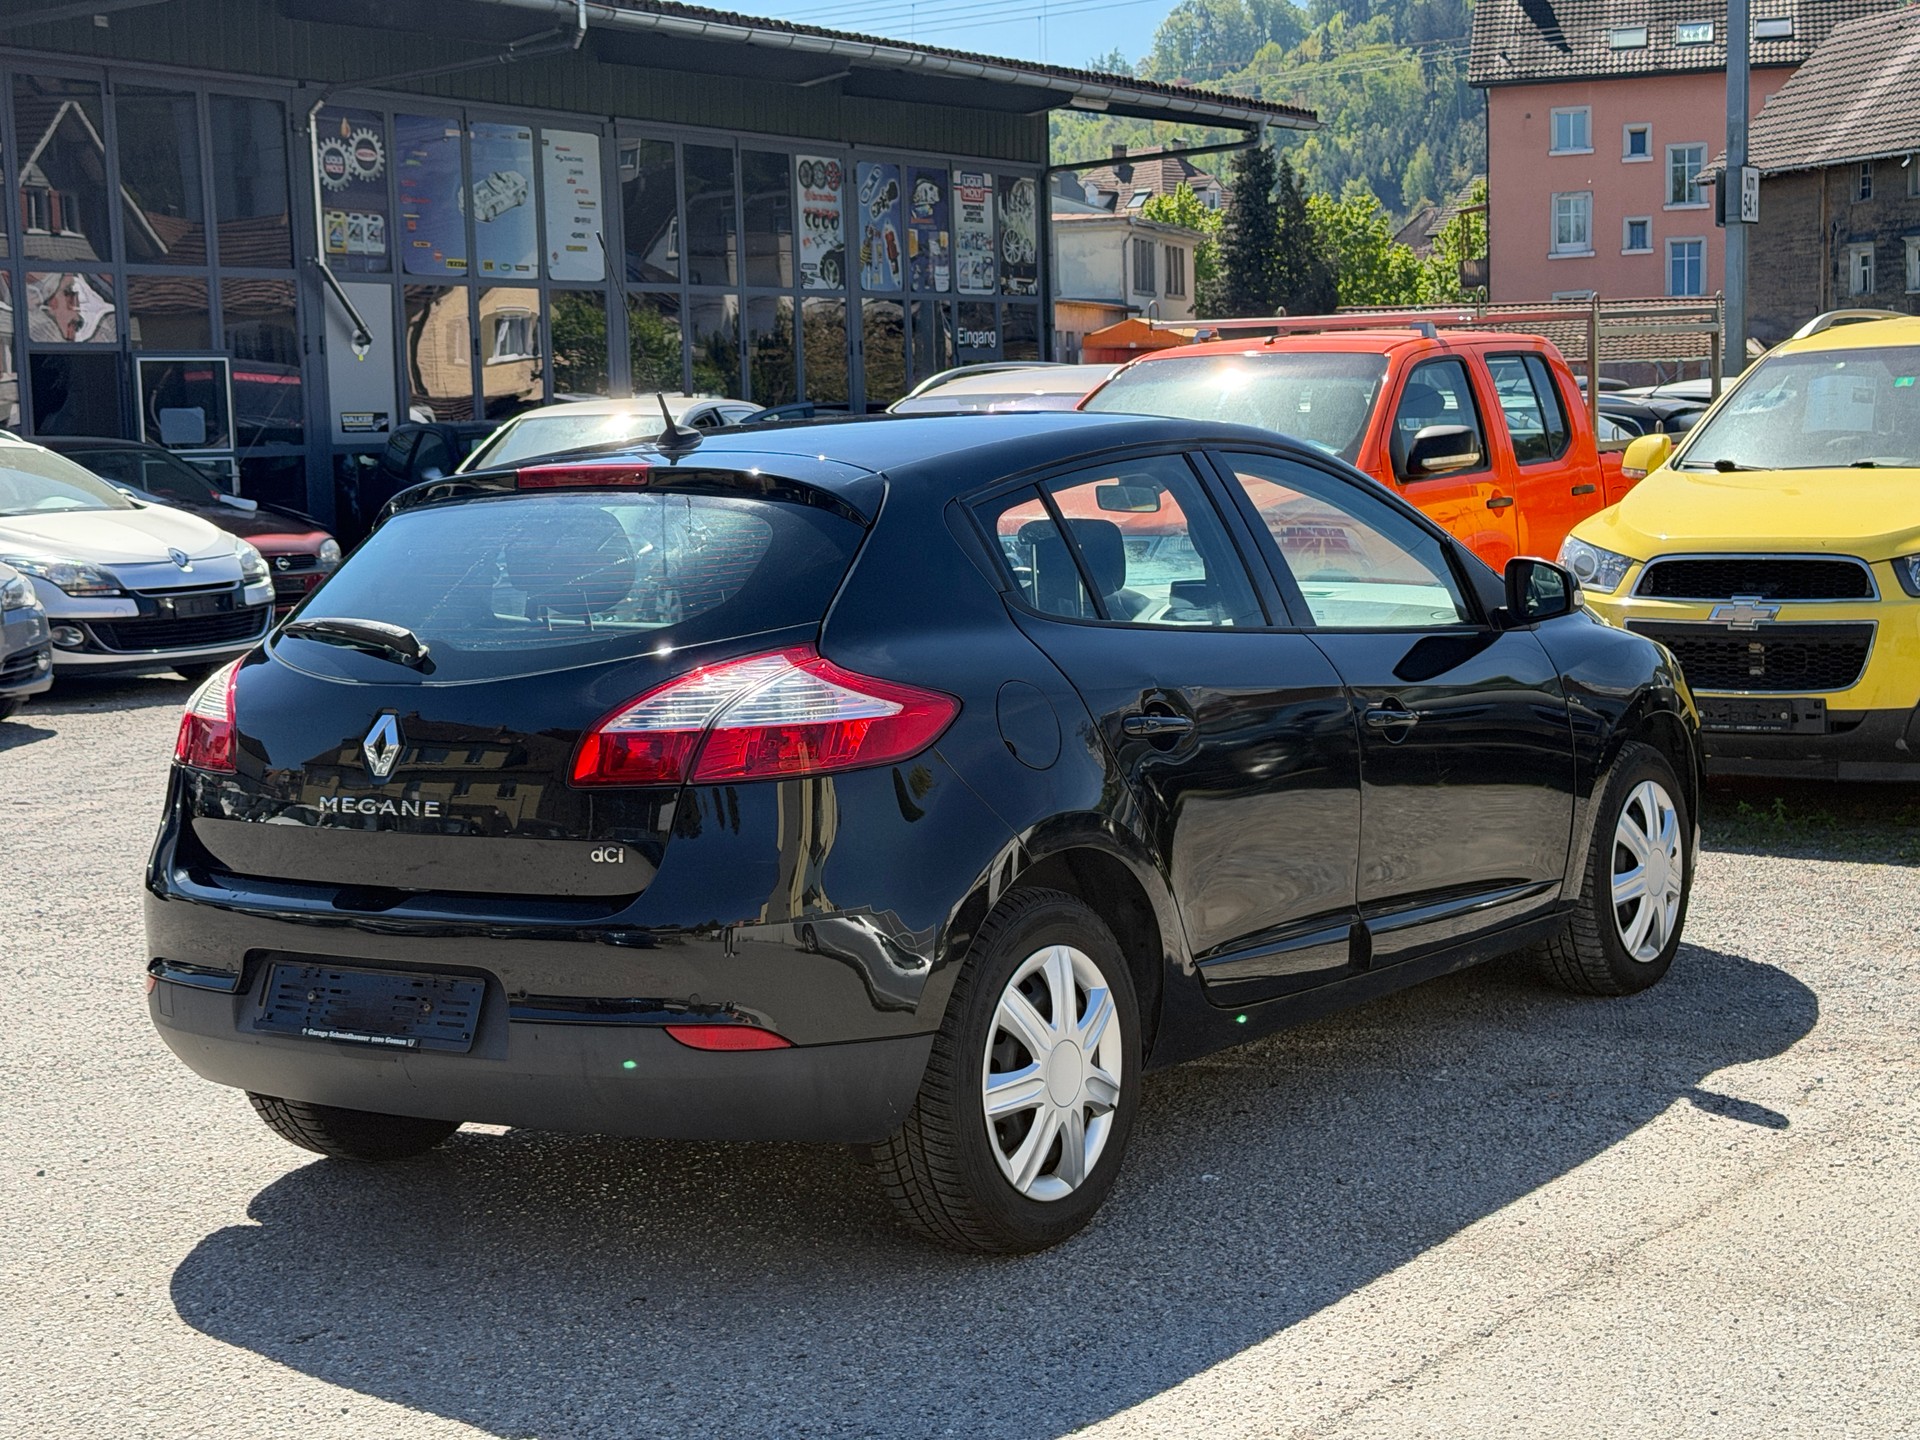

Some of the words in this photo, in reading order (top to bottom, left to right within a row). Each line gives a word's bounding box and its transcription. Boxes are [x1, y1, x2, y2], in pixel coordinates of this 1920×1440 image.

[963, 187, 982, 199] MOLY
[1743, 193, 1757, 218] 54.1
[446, 260, 467, 268] TEXTA
[957, 327, 996, 349] Eingang
[319, 796, 441, 818] MEGANE
[590, 846, 624, 864] dCi
[307, 1028, 329, 1038] Garage
